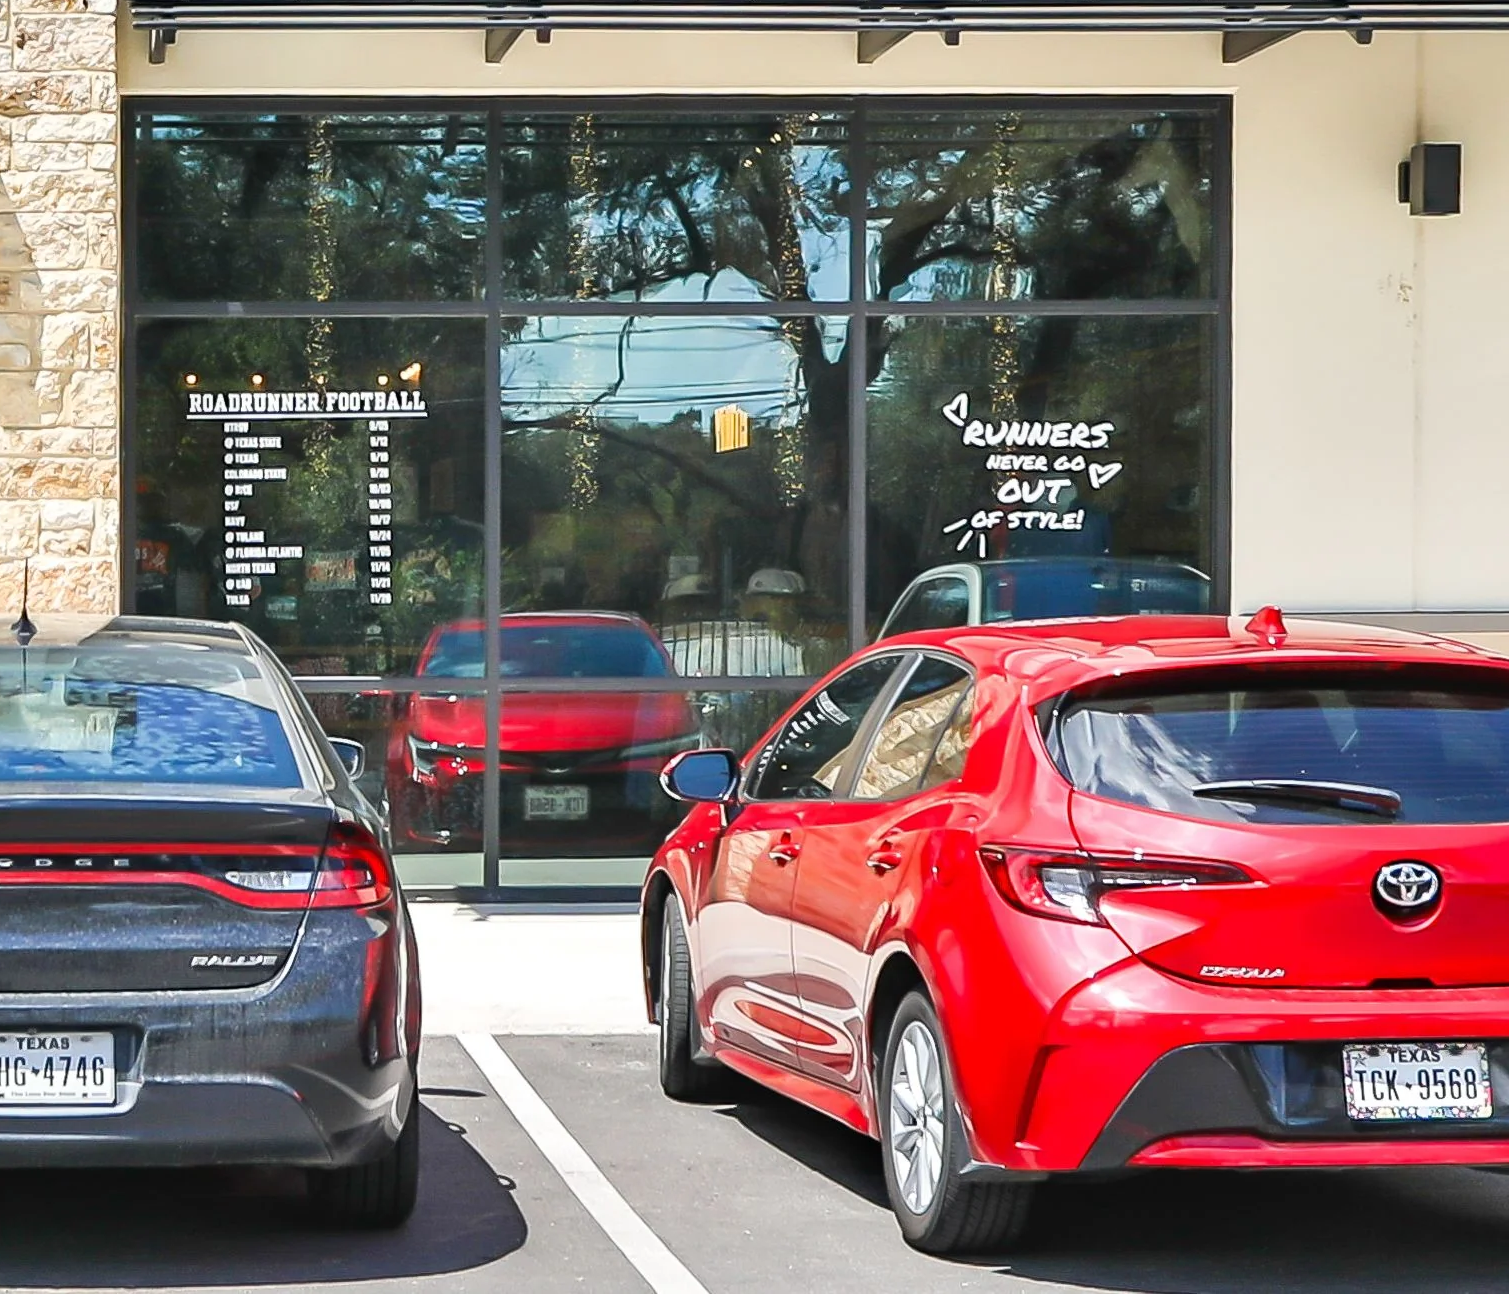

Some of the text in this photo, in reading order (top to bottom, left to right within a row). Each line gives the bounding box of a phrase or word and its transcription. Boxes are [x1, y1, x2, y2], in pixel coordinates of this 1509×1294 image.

[189, 390, 426, 414] ROADRUNNER FOOTBALL
[963, 420, 1115, 448] RUNNERS
[986, 455, 1086, 471] NEVER GO
[997, 478, 1072, 504] OUT
[971, 509, 1085, 530] OF STYLE!
[1199, 965, 1286, 979] COROLLA
[15, 1037, 71, 1051] TEXAS
[1390, 1049, 1442, 1064] TEXAS
[43, 1056, 105, 1087] 4746
[1355, 1068, 1479, 1101] TCK 9568
